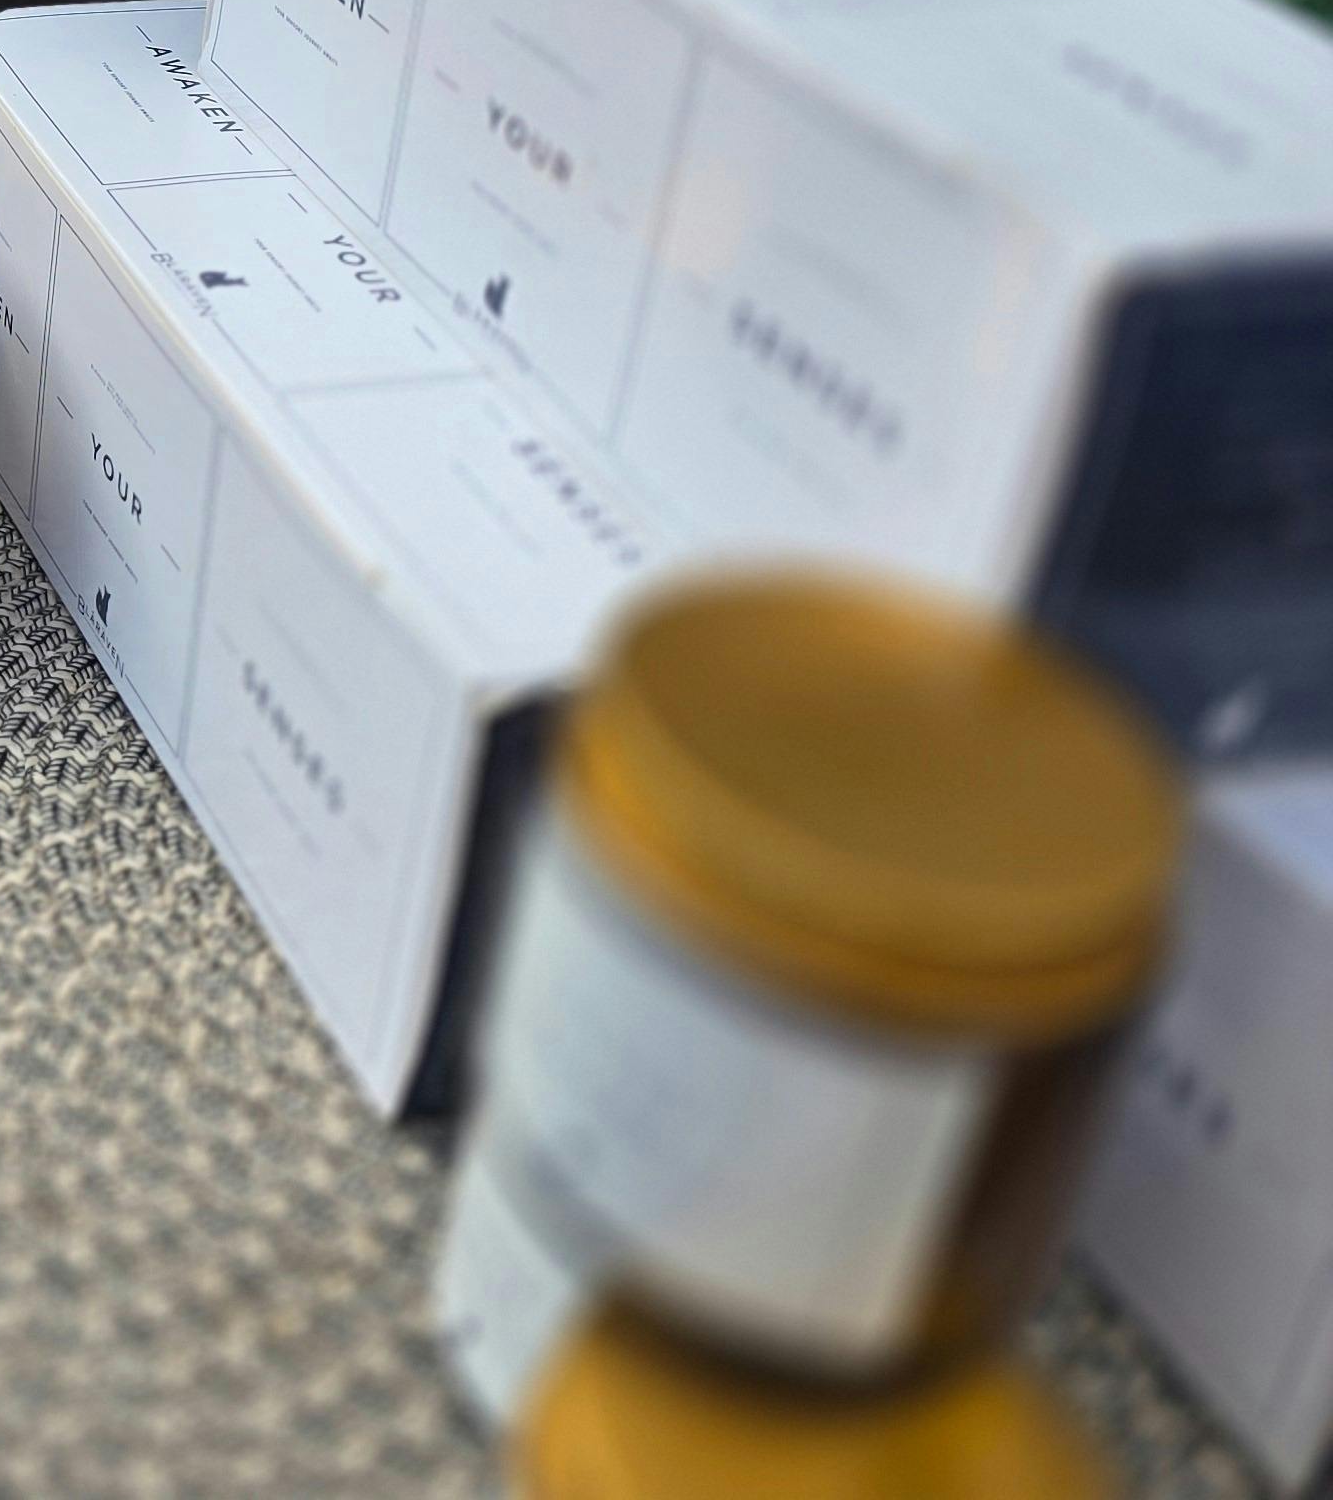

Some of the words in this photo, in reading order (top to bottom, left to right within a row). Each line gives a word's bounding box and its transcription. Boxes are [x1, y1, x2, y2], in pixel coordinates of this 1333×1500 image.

[146, 43, 243, 133] AWAKEN
[488, 97, 572, 184] YOUR
[323, 234, 401, 304] YOUR
[90, 432, 143, 525] YOUR
